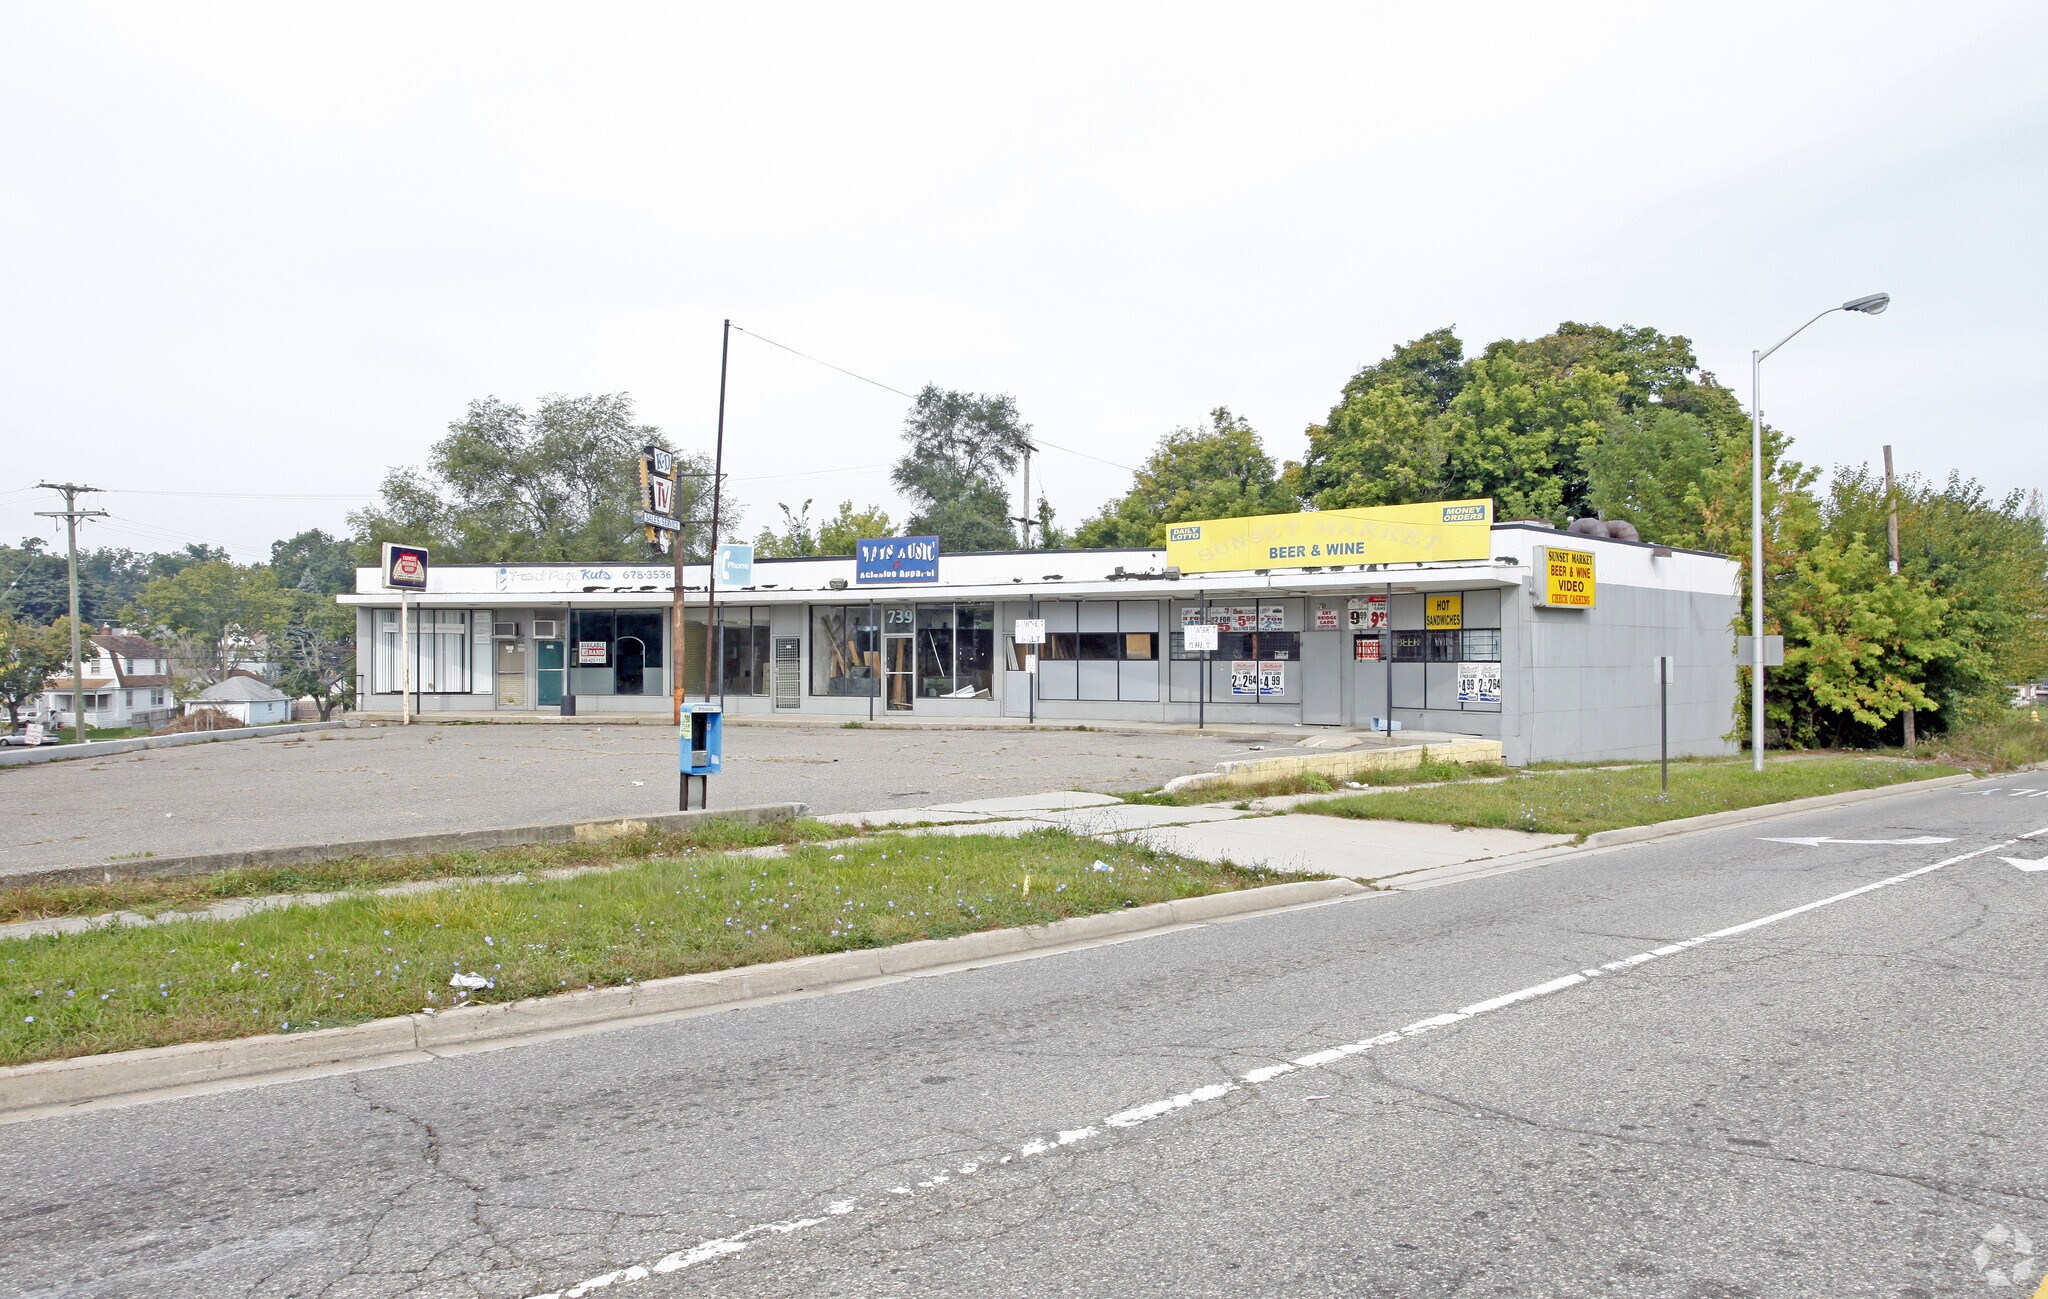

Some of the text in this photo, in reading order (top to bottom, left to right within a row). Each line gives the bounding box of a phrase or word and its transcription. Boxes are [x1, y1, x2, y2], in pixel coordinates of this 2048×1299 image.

[656, 481, 670, 509] TV
[1446, 506, 1482, 515] MONEY
[1443, 512, 1484, 522] ORDERS
[1171, 533, 1199, 541] LOTTO
[1173, 527, 1198, 535] DAILY
[1198, 519, 1443, 562] SUNSET MARKET
[1269, 542, 1365, 559] BEER & WINE
[1548, 551, 1593, 565] SUNSET MARKET
[727, 561, 749, 570] Phone
[580, 569, 613, 581] Kuts
[622, 570, 672, 580] 678-3536
[1551, 565, 1591, 579] BEER & WINE
[1558, 580, 1585, 593] VIDEO
[1436, 600, 1450, 611] HOT
[1551, 594, 1590, 605] CHECK CASHING
[887, 609, 914, 624] 739
[1426, 614, 1461, 626] SANDWICHES
